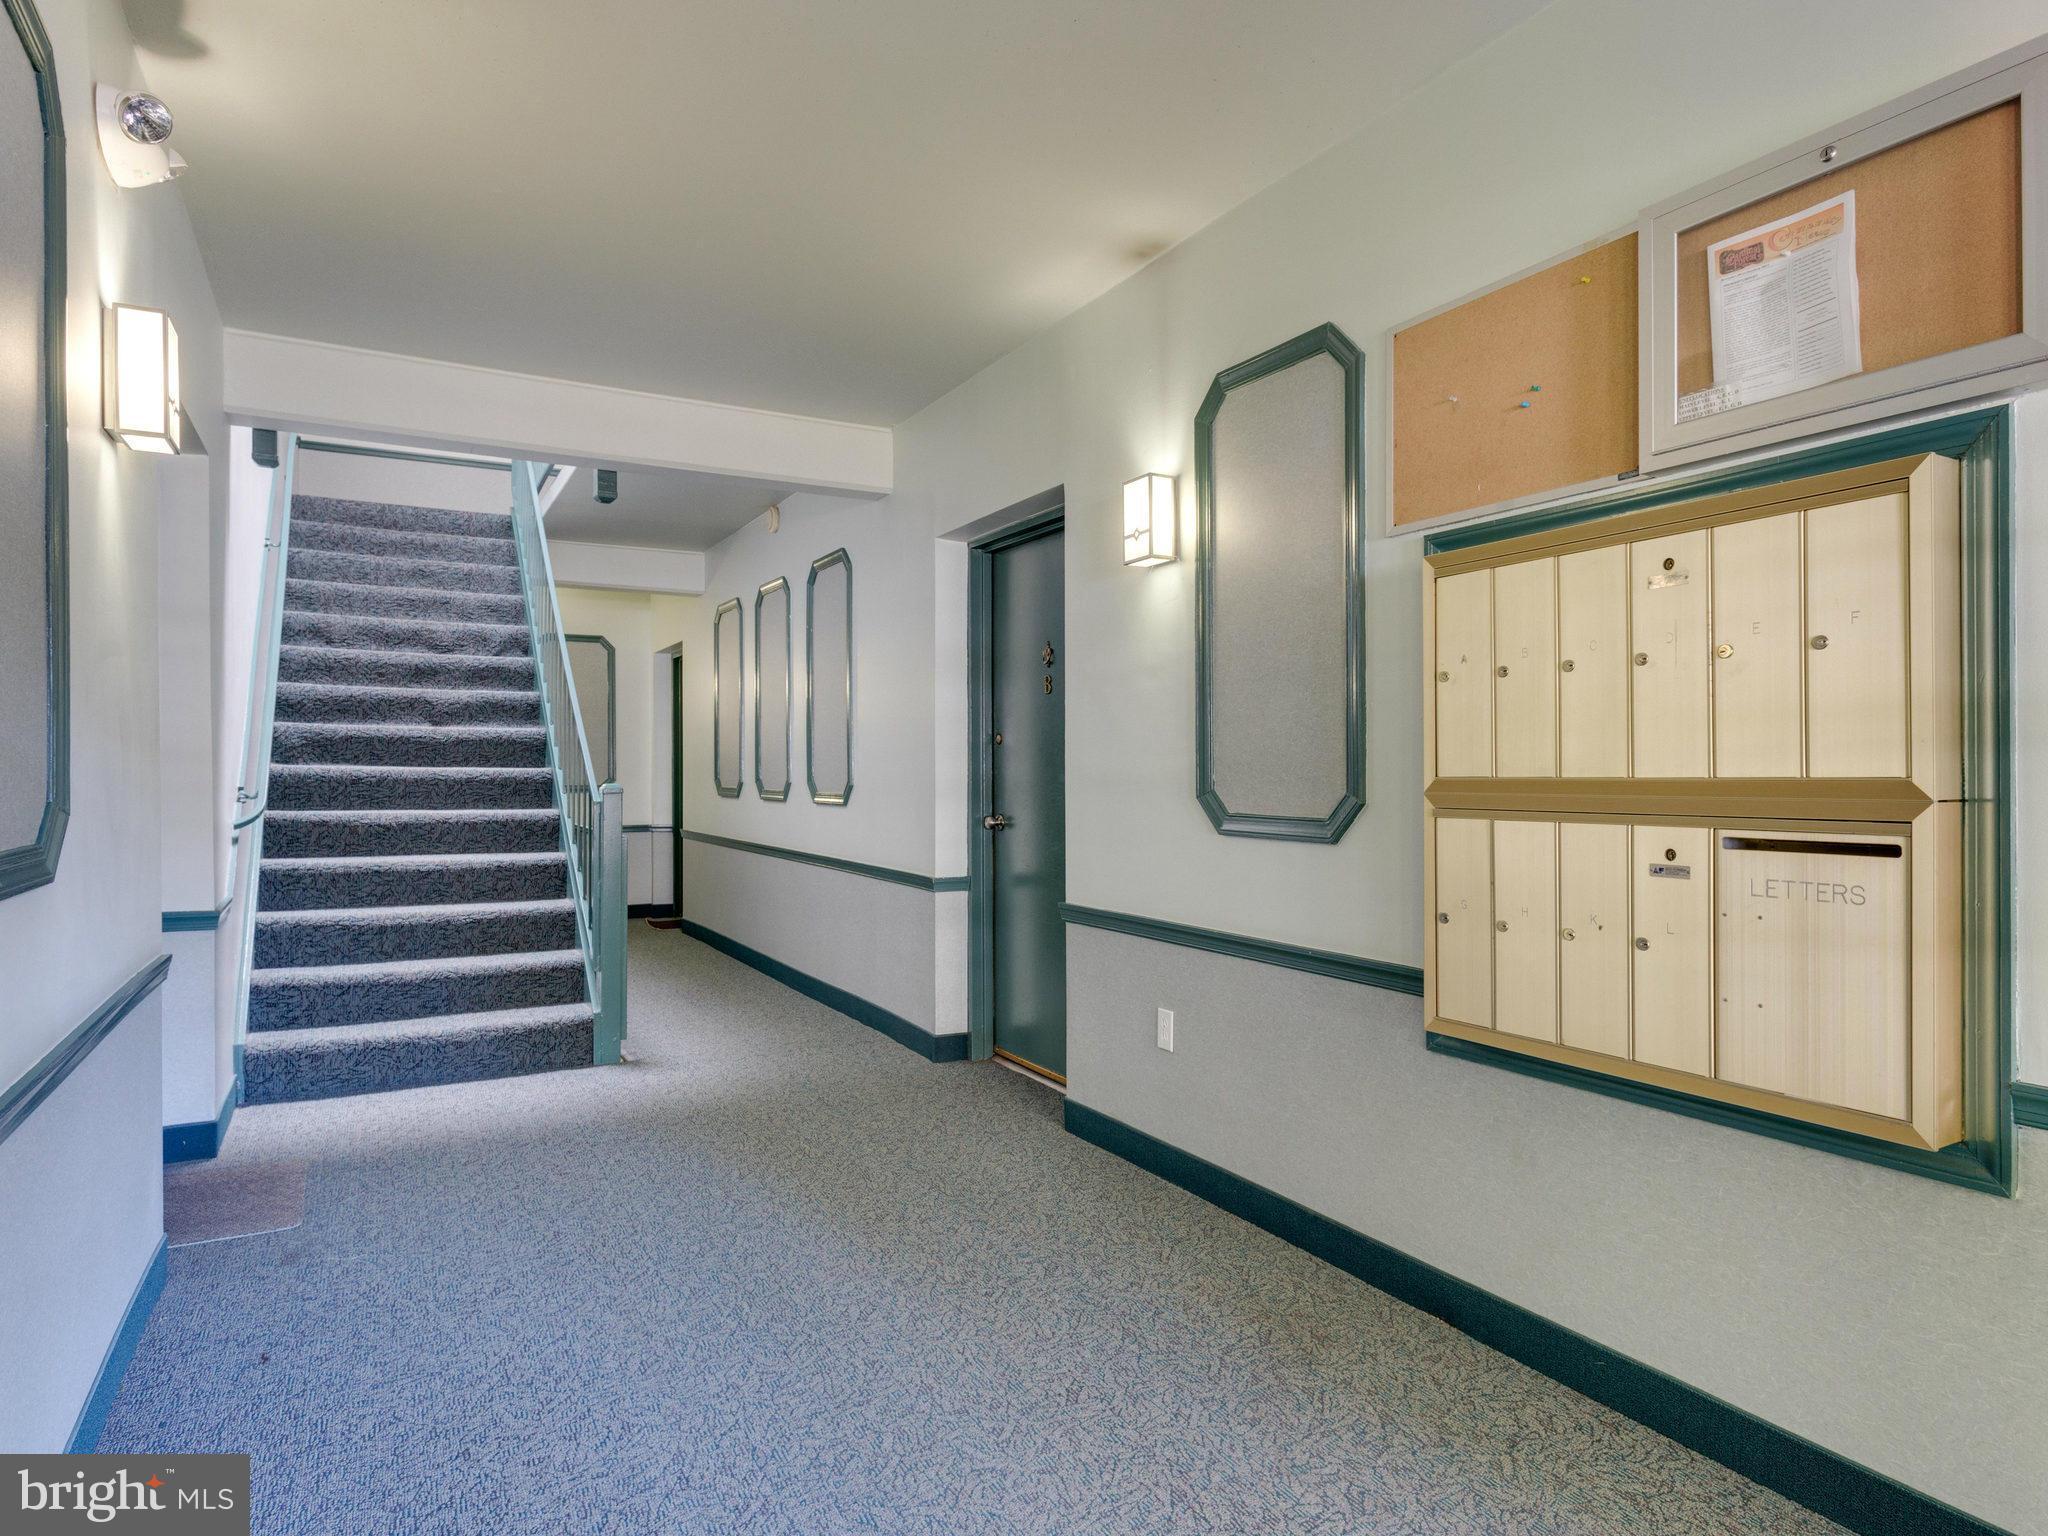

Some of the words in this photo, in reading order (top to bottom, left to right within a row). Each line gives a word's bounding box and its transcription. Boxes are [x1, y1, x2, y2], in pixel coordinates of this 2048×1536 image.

[1850, 610, 1860, 624] F
[1752, 621, 1761, 634] E
[1589, 640, 1597, 651] C
[1520, 648, 1528, 658] B
[1460, 654, 1467, 664] A
[1044, 674, 1053, 694] B
[1750, 878, 1866, 906] LETTERS
[1460, 899, 1468, 910] G
[1521, 906, 1529, 917] H
[1590, 914, 1599, 925] K
[1666, 922, 1675, 934] L
